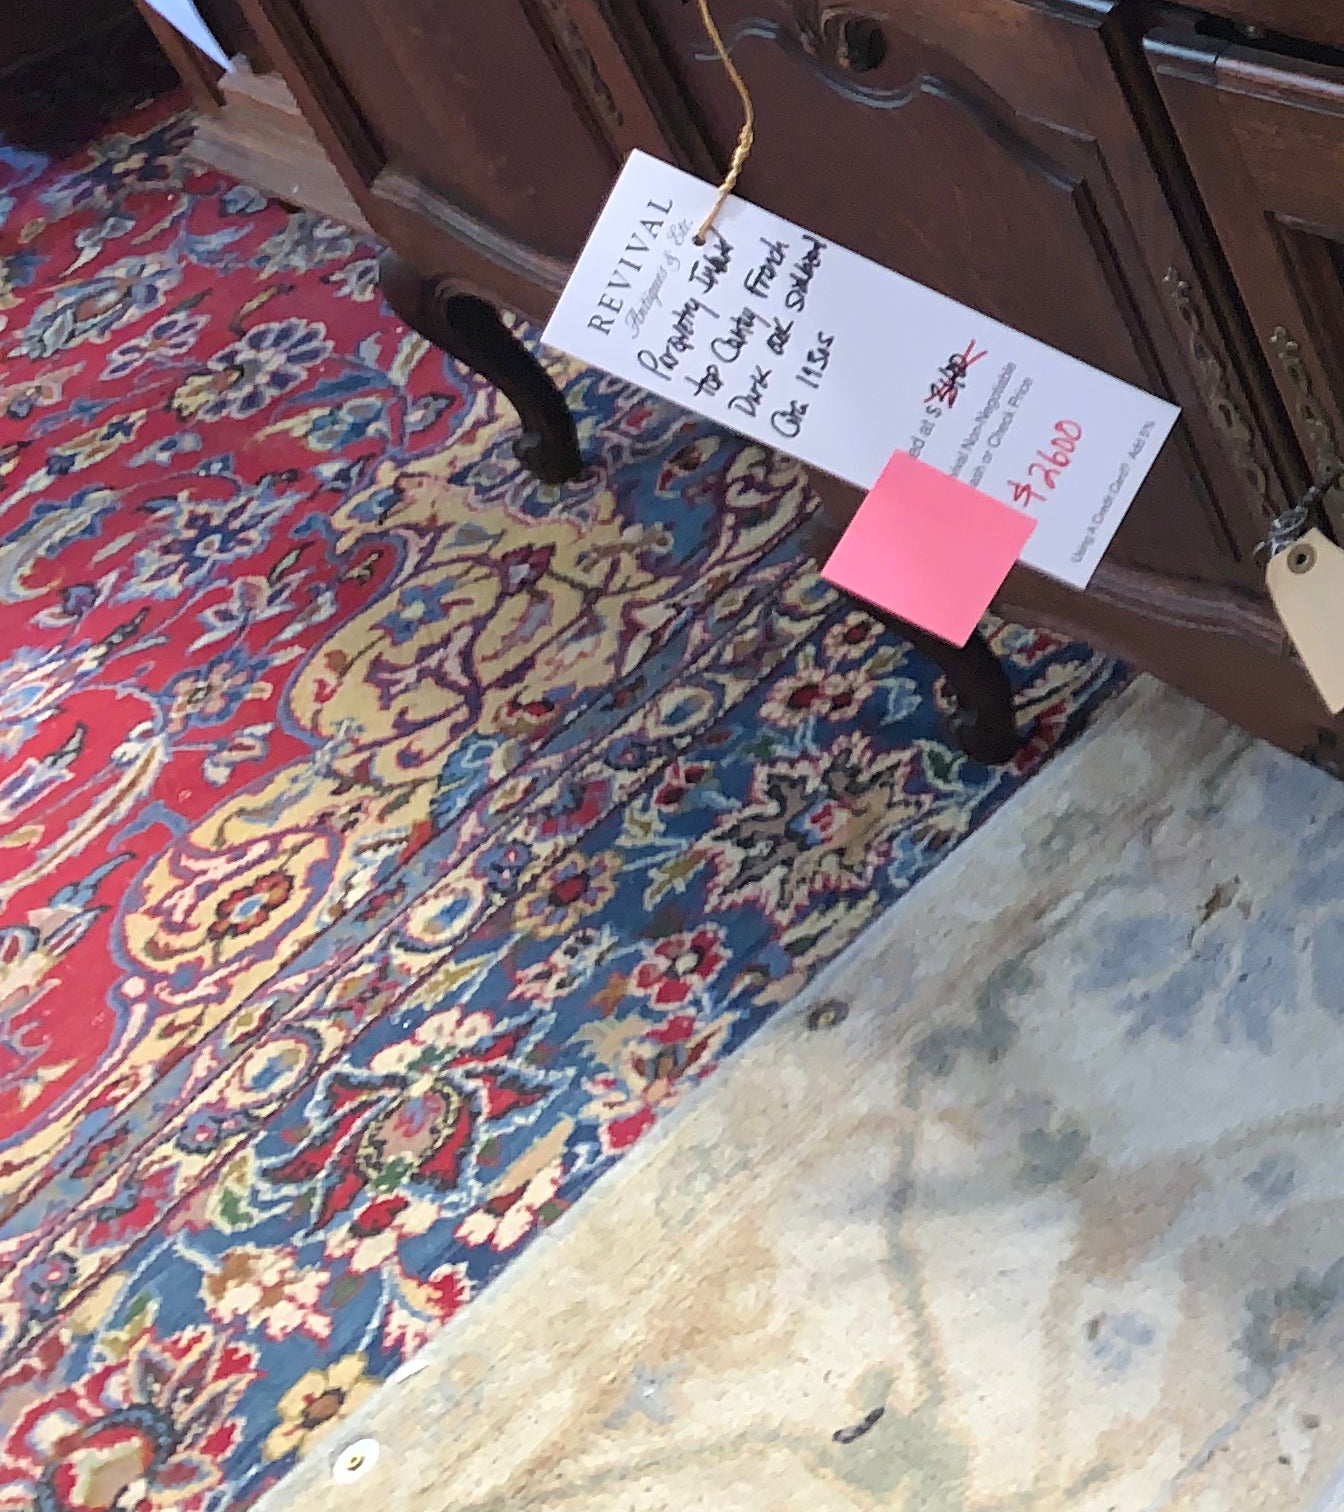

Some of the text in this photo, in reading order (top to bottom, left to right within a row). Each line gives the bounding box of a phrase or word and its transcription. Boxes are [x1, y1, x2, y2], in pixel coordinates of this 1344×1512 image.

[587, 200, 673, 336] REVIVAL
[919, 419, 935, 436] at
[960, 362, 1016, 451] Non-Negotiable
[970, 377, 1032, 487] ash or Check Price
[1071, 535, 1095, 562] Using
[1092, 494, 1115, 524] Credit
[1128, 438, 1145, 460] Add
